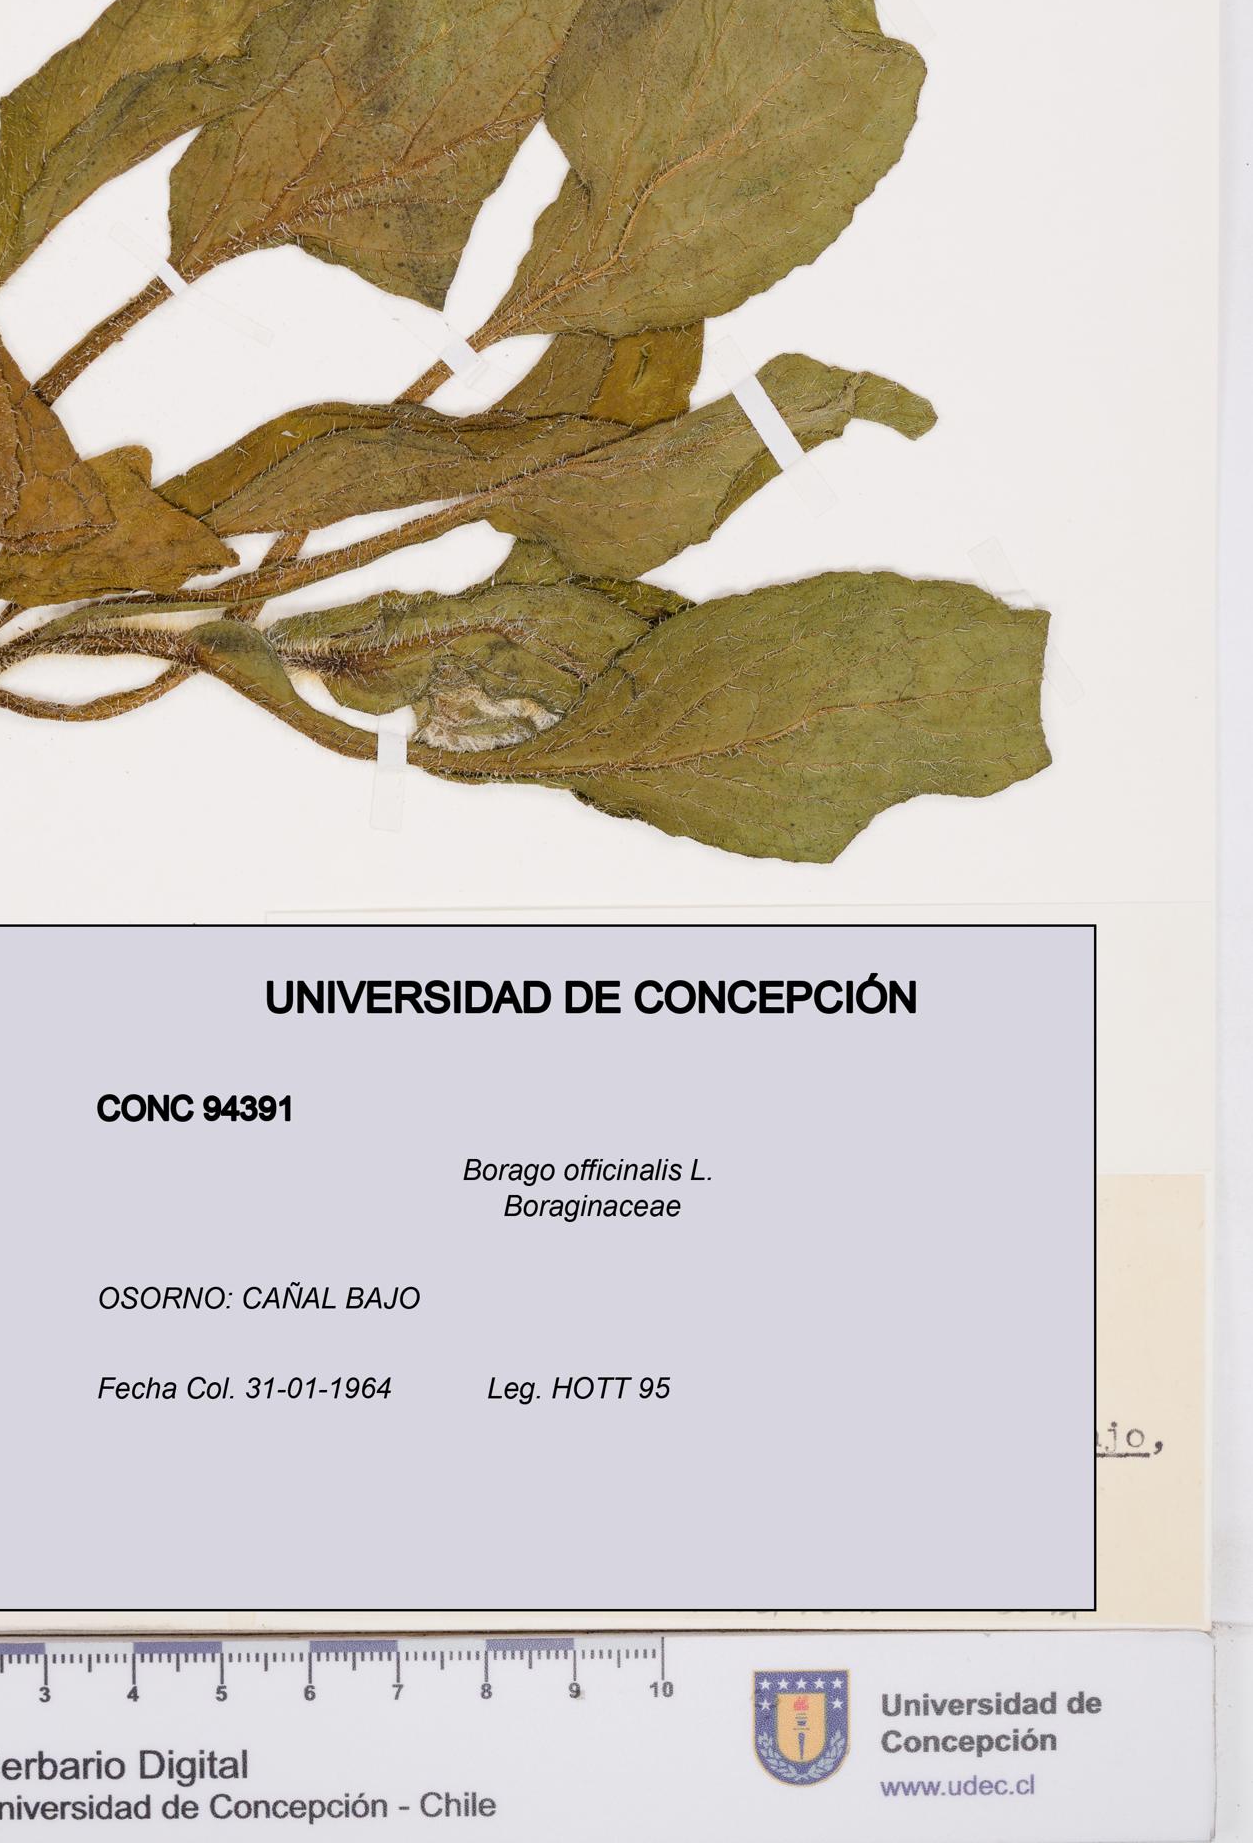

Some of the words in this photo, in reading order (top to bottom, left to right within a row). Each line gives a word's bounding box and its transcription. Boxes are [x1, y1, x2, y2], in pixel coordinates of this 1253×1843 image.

[1096, 1420, 1165, 1456] jo,
[38, 1686, 52, 1703] 3
[126, 1685, 140, 1703] 4
[215, 1684, 228, 1702] 5
[303, 1684, 316, 1702] 6
[391, 1683, 404, 1701] 7
[480, 1682, 493, 1700] 8
[568, 1682, 582, 1699] 9
[649, 1681, 674, 1698] 10
[881, 1691, 1057, 1717] Universidad
[1066, 1690, 1103, 1715] de
[880, 1727, 1057, 1758] Concepción
[139, 1749, 248, 1788] Digital
[879, 1773, 1035, 1797] www.udec.cl
[161, 1793, 200, 1820] de
[209, 1792, 388, 1825] Concepción
[419, 1791, 497, 1818] Chile
